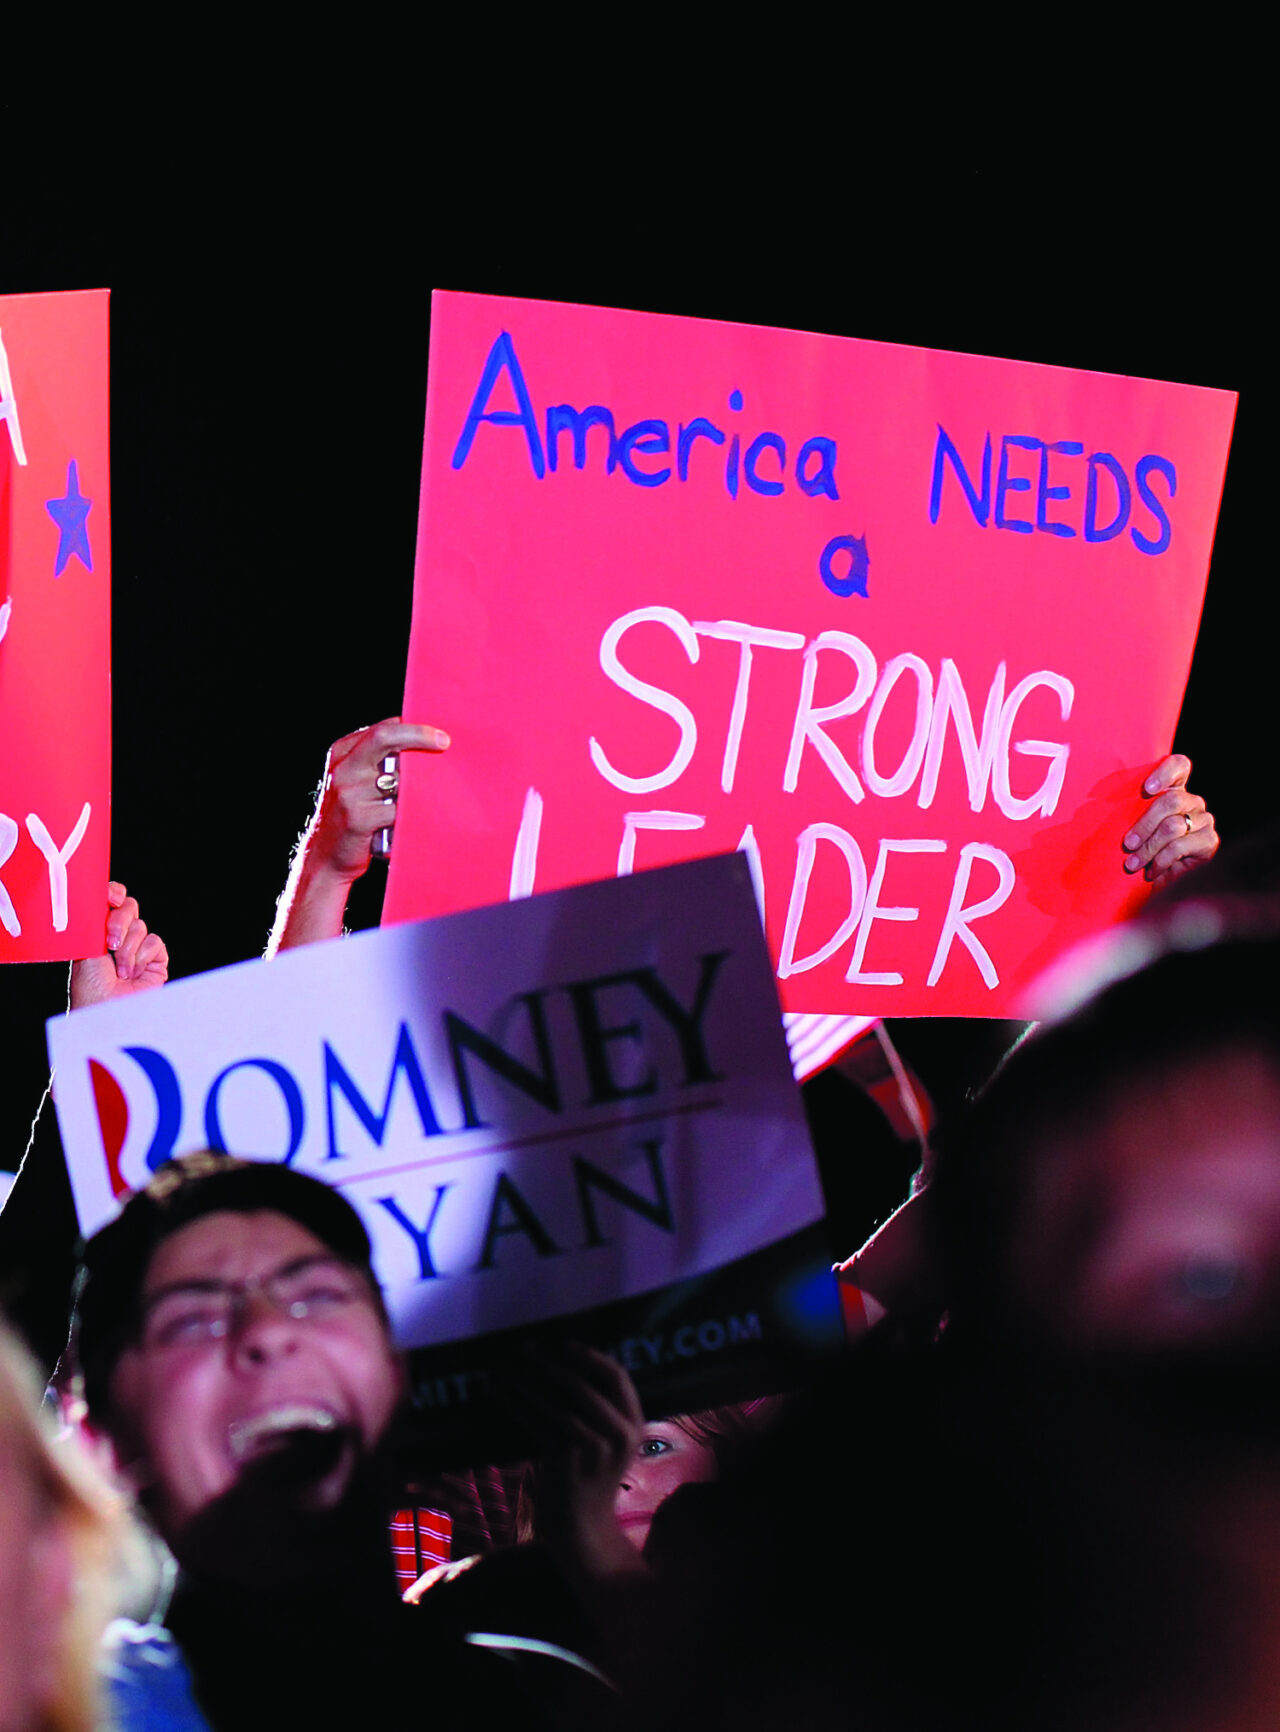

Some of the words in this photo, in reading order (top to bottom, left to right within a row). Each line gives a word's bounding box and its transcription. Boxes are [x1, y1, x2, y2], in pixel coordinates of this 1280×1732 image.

[450, 330, 840, 501] America
[928, 422, 1177, 556] NEEDS
[819, 532, 870, 599] a
[589, 605, 1075, 821] STRONG
[87, 949, 731, 1199] ROMNEY
[372, 1138, 677, 1281] YAN
